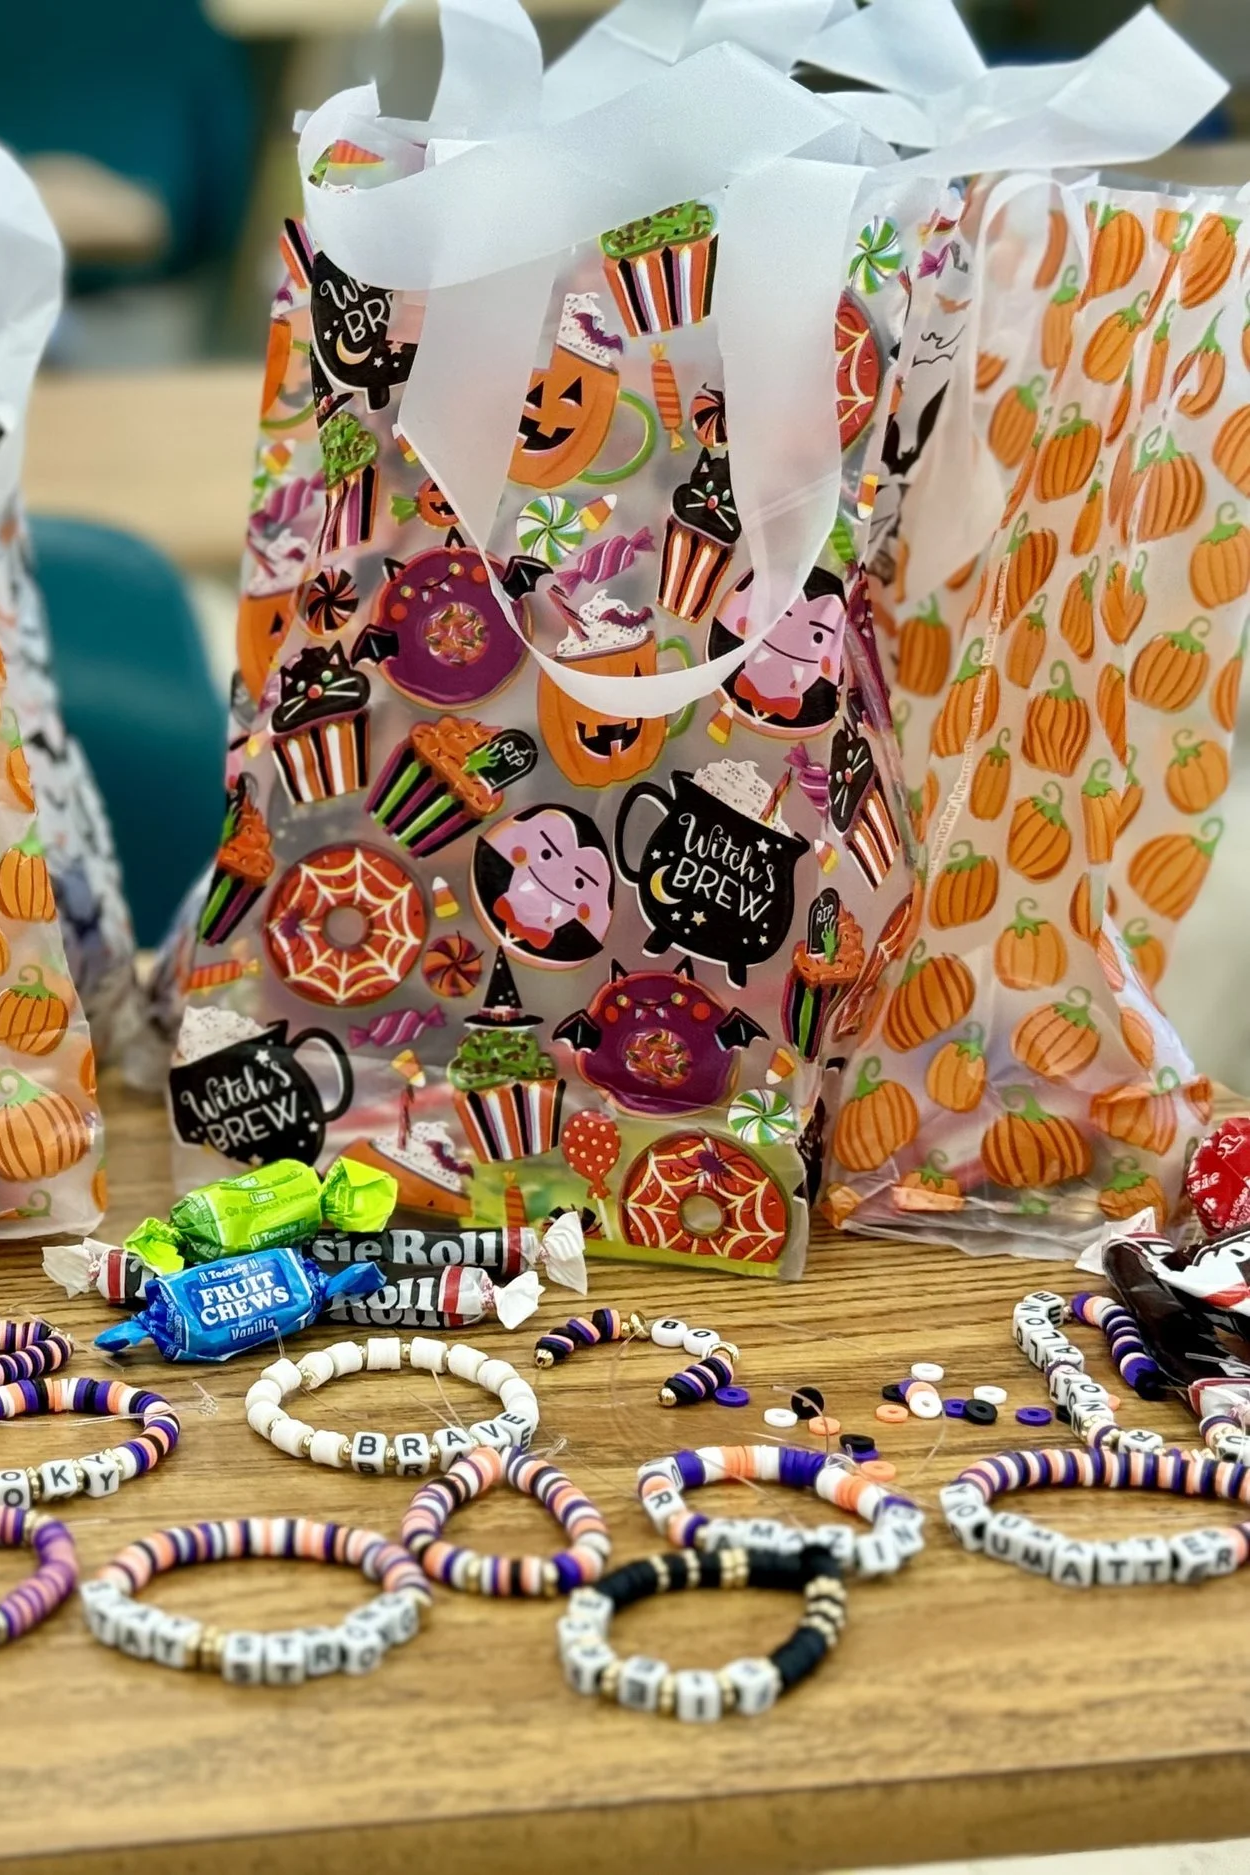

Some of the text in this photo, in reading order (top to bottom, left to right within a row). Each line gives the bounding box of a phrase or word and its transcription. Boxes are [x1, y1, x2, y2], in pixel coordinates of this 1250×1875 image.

[500, 741, 525, 767] RIP
[678, 812, 776, 893] Witch's
[672, 857, 772, 922] BREW
[815, 903, 834, 926] RIP
[180, 1060, 293, 1124] Witch's
[206, 1090, 297, 1152] BREW
[261, 1222, 300, 1243] Tootsie
[389, 1228, 499, 1267] Roll
[199, 1271, 275, 1307] FRUIT
[208, 1262, 249, 1280] Tootsie
[200, 1286, 290, 1327] CHEWS
[231, 1317, 277, 1341] Vanilla
[356, 1411, 532, 1477] BRAVE
